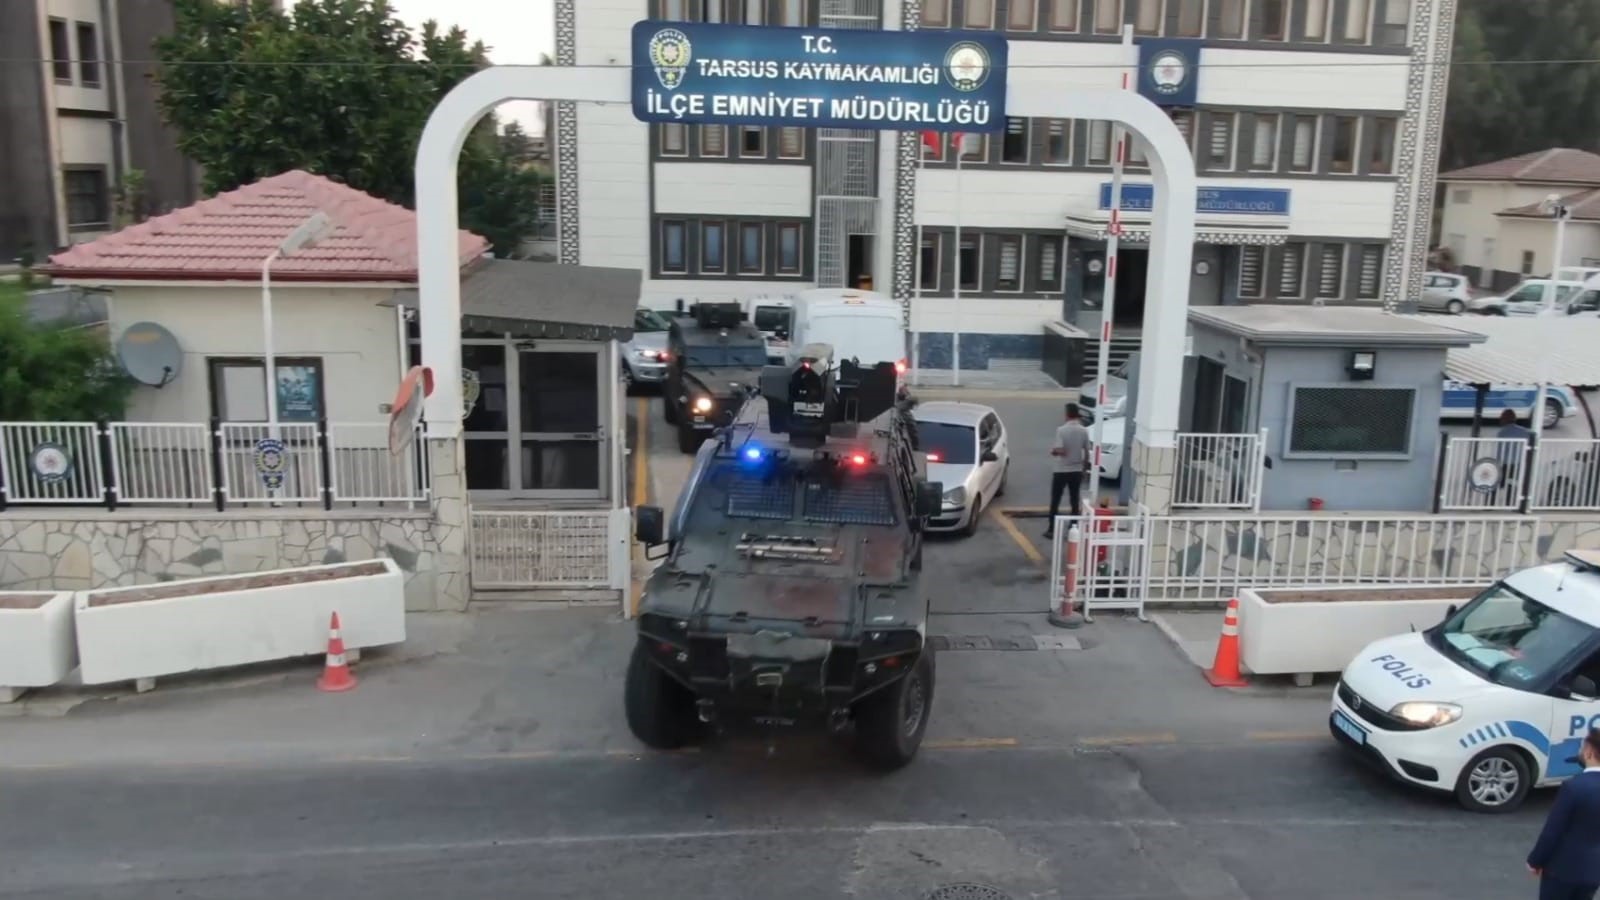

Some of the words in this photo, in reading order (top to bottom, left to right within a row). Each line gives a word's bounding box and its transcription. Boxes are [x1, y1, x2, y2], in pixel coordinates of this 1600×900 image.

[801, 35, 838, 54] T.C.
[696, 58, 778, 79] TARSUS
[783, 62, 939, 85] KAYMAKAMLIĞI
[647, 88, 705, 119] İLÇE
[713, 91, 824, 118] EMNİYET
[831, 95, 990, 125] MÜDÜRLÜĞÜ
